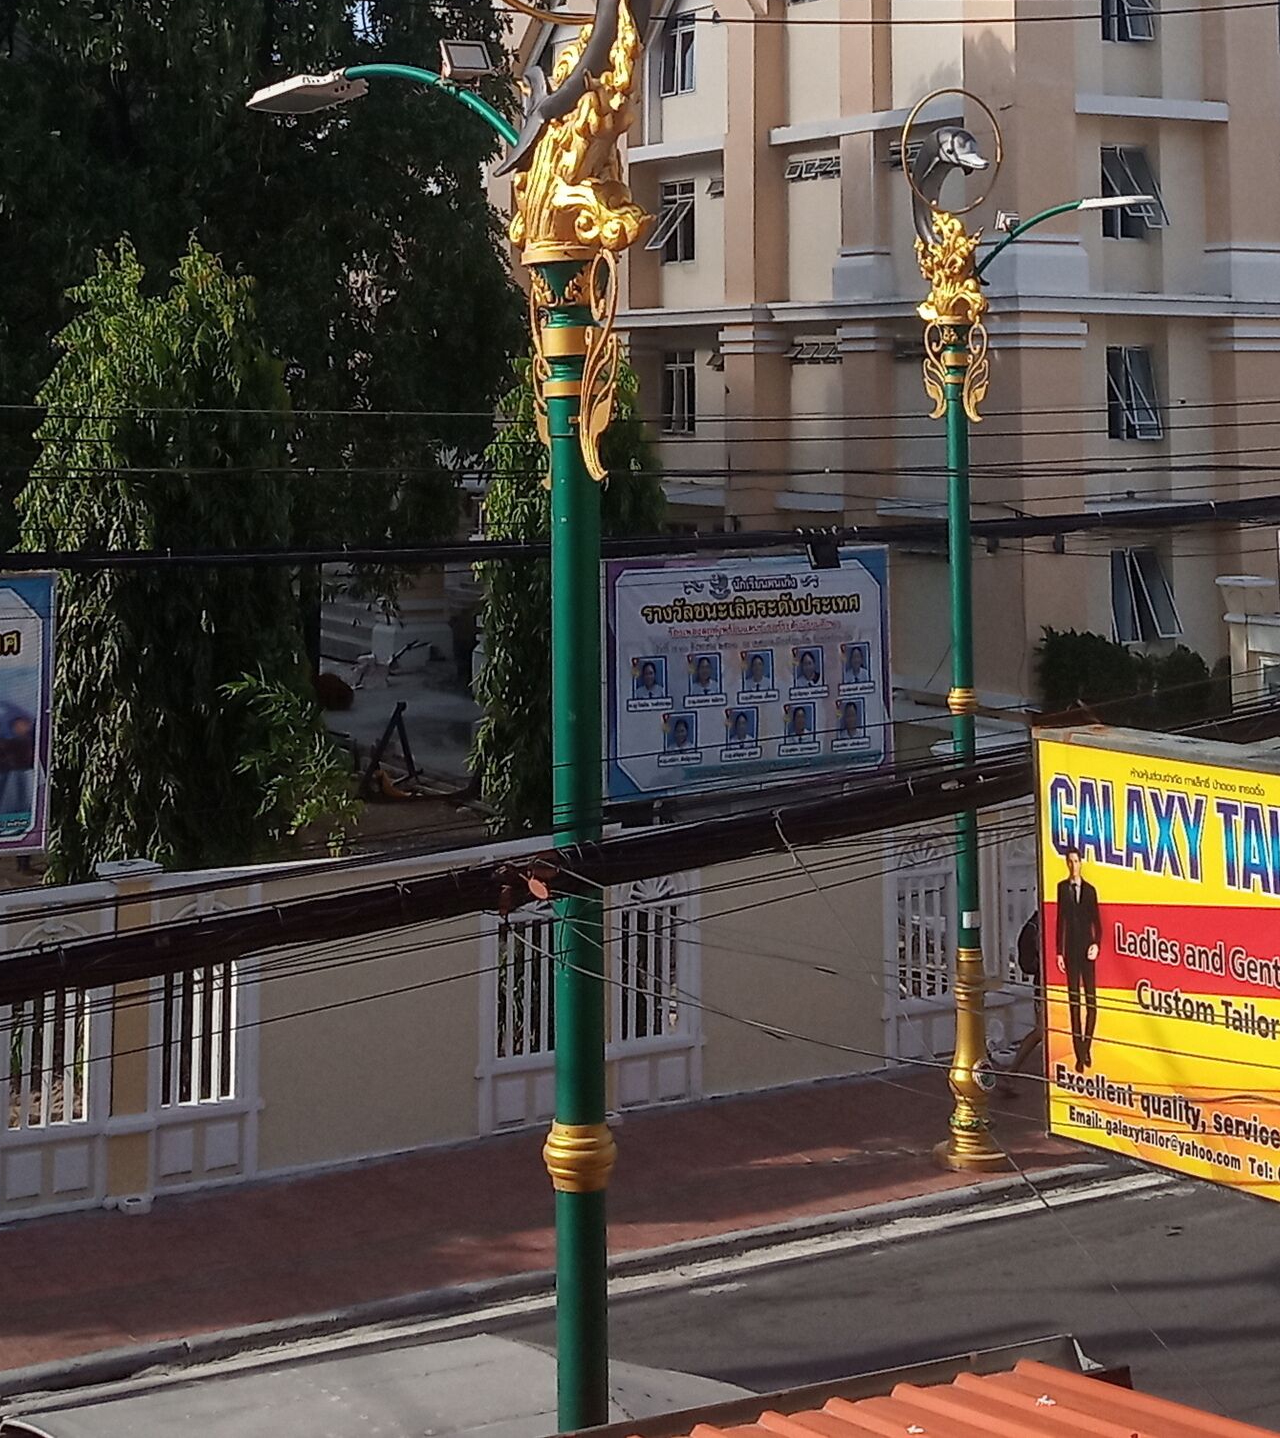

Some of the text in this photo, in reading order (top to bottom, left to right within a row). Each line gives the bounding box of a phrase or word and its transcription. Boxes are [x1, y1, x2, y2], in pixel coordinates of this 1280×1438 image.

[1050, 775, 1205, 883] GALAXY
[1115, 923, 1179, 964] Ladies
[1185, 941, 1224, 973] and
[1137, 982, 1280, 1040] Custom Tailor
[1056, 1064, 1134, 1106] Excellent
[1140, 1091, 1206, 1132] quality,
[1213, 1113, 1280, 1148] service
[1069, 1105, 1102, 1129] Email:
[1105, 1118, 1241, 1170] galaxytailor@yahoo.com
[1248, 1157, 1273, 1180] Tel:
